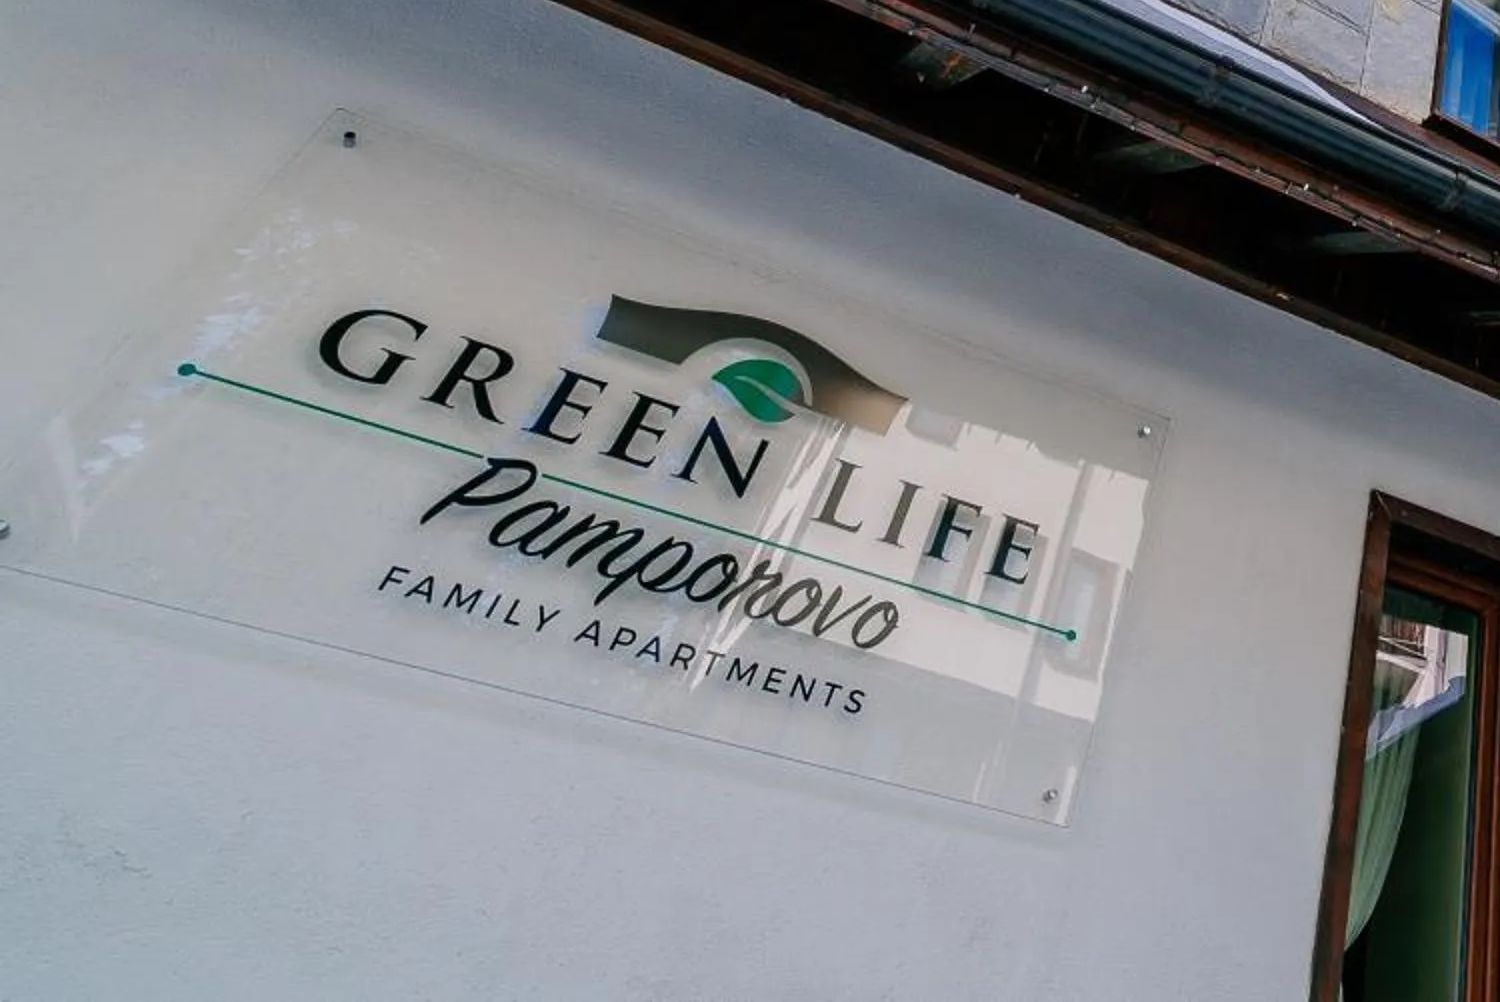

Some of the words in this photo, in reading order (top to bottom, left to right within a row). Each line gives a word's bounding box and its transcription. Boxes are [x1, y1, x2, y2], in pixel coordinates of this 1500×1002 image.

[318, 308, 770, 499] GREEN
[812, 457, 1041, 585] LIFE
[377, 565, 561, 633] FAMILY
[574, 619, 867, 716] APARTMENTS
[420, 457, 900, 650] Pamporovo
